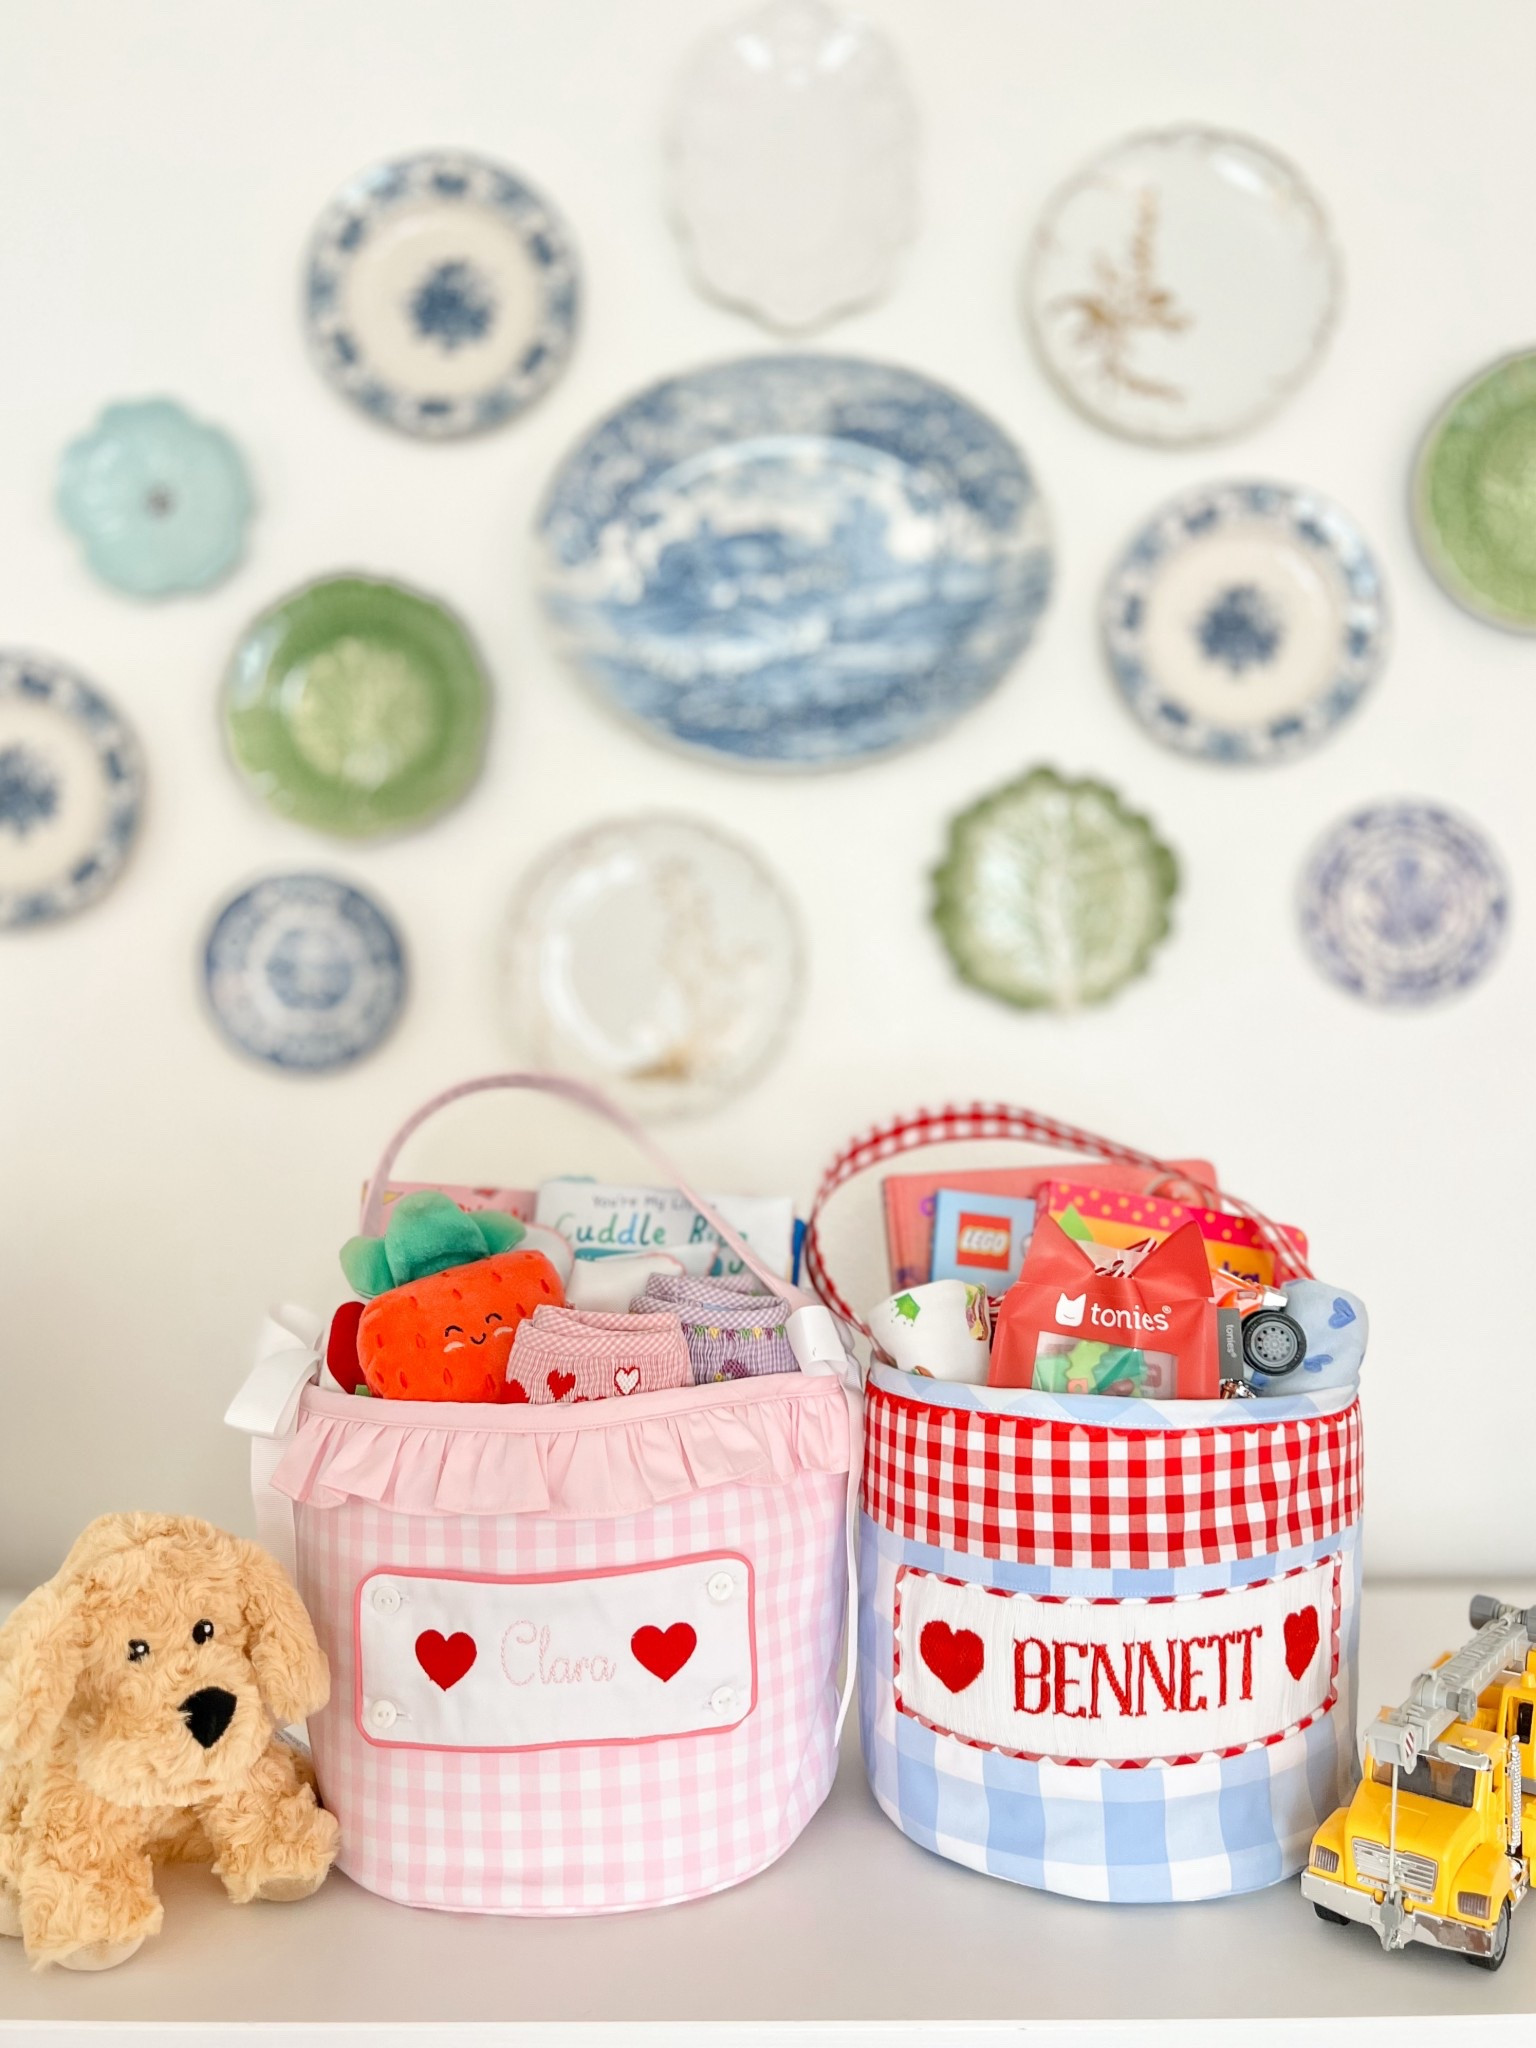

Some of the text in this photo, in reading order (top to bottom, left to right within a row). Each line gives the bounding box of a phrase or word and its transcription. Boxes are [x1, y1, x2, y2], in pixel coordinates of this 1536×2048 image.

[555, 1211, 665, 1246] Cuddle
[960, 1227, 1009, 1256] LEGO
[500, 1619, 617, 1686] Clara
[1013, 1625, 1262, 1719] BENNETT
